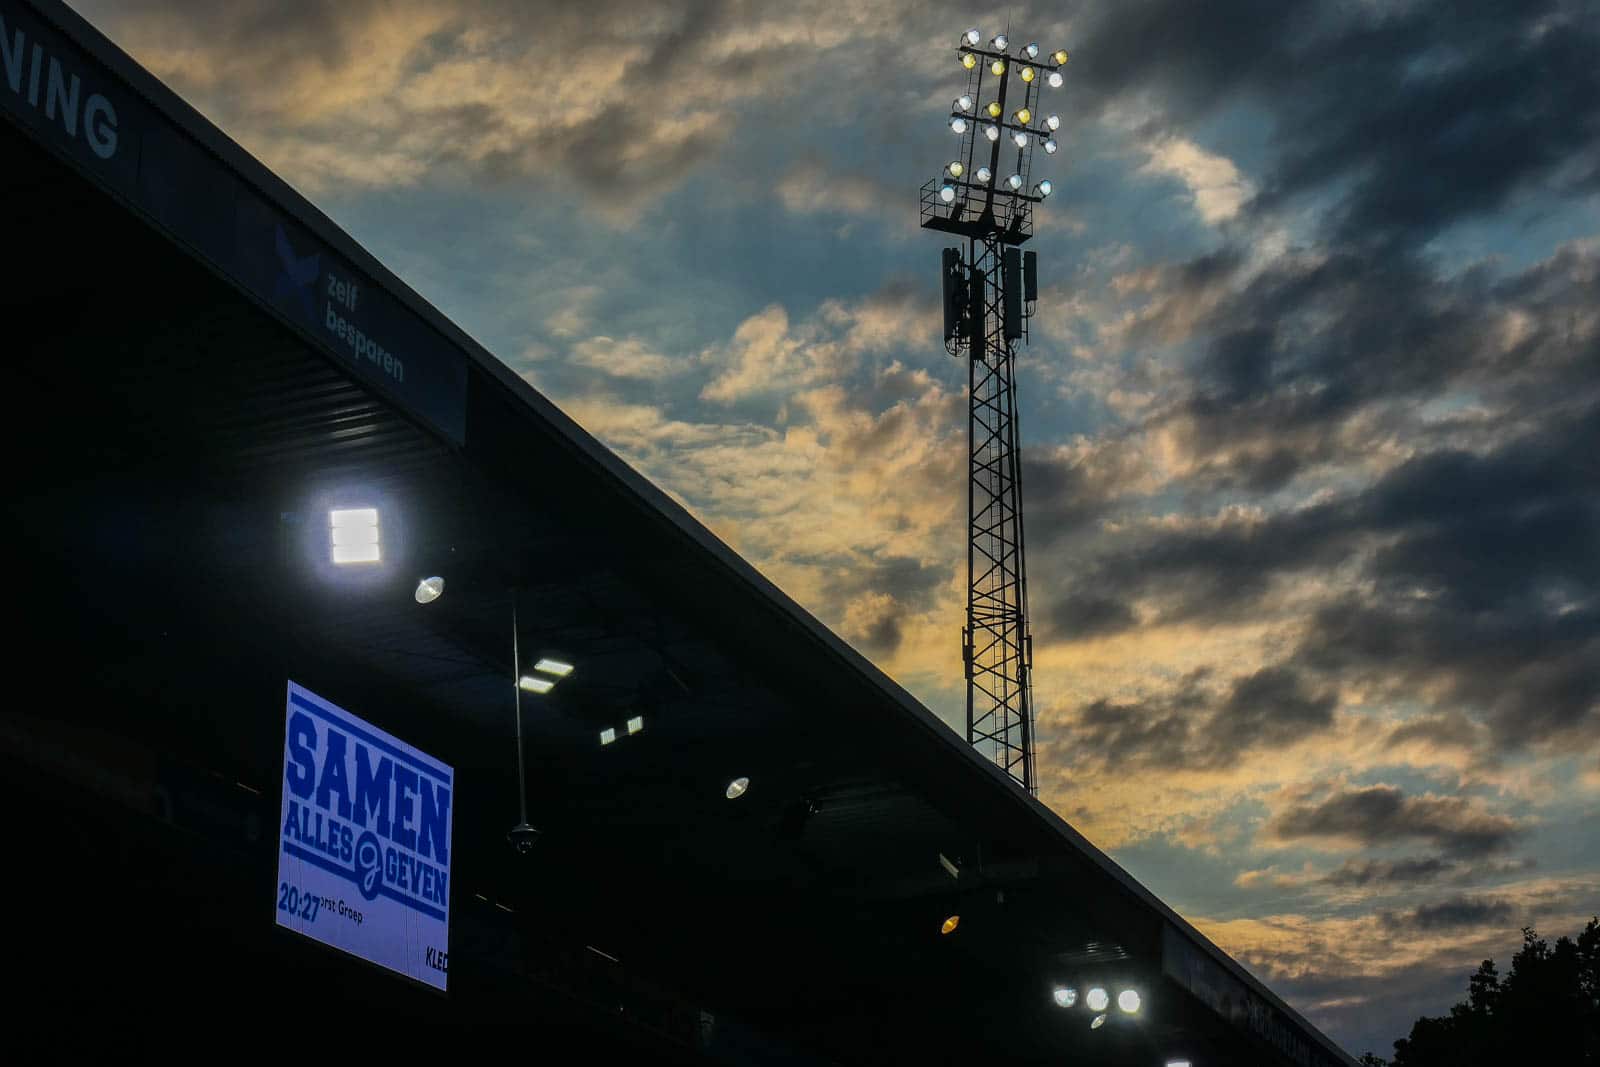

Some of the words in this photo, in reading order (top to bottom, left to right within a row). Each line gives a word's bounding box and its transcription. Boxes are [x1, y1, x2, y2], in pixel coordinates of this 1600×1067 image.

[0, 15, 119, 159] NING
[328, 273, 360, 312] zelf
[326, 301, 404, 384] besparen
[287, 712, 449, 865] SAMEN
[284, 802, 354, 862] ALLES
[386, 850, 447, 906] GEVEN
[278, 883, 320, 922] 20:27
[339, 901, 363, 924] Groep
